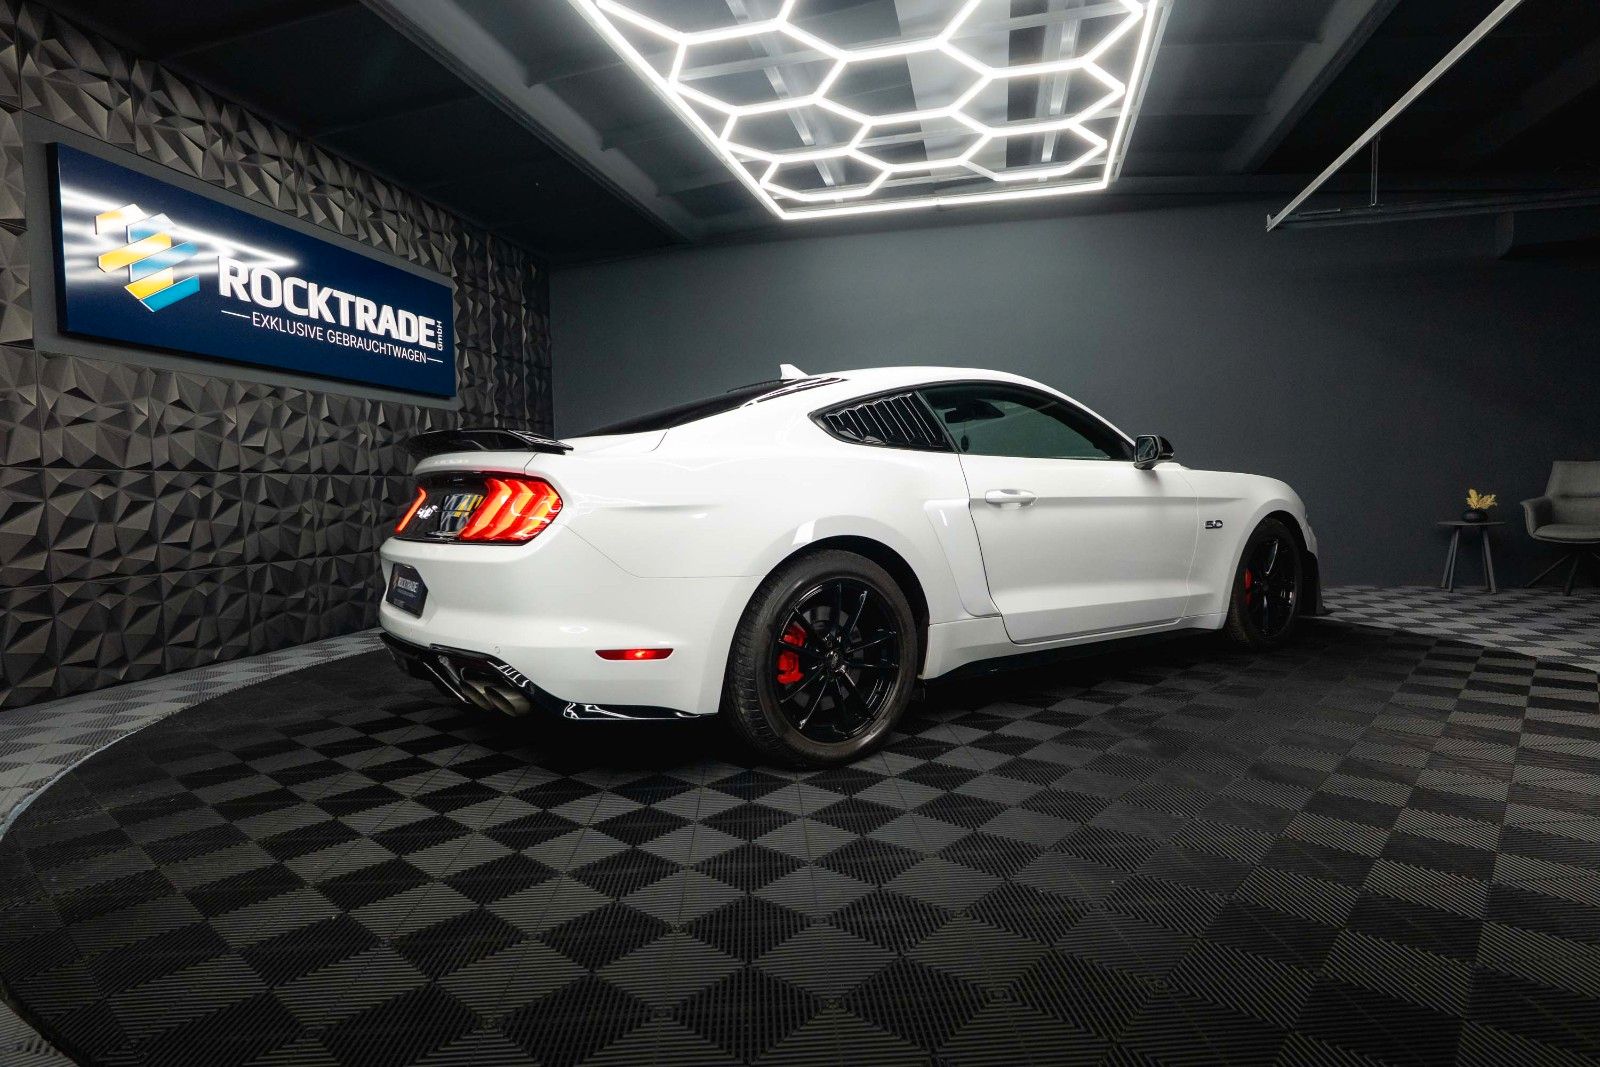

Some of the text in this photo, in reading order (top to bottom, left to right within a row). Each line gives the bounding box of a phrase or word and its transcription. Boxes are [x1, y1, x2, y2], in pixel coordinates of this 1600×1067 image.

[218, 255, 436, 349] ROCKTRADE
[252, 312, 427, 364] EXKLUSIVE GEBRAUCHTWAGEN
